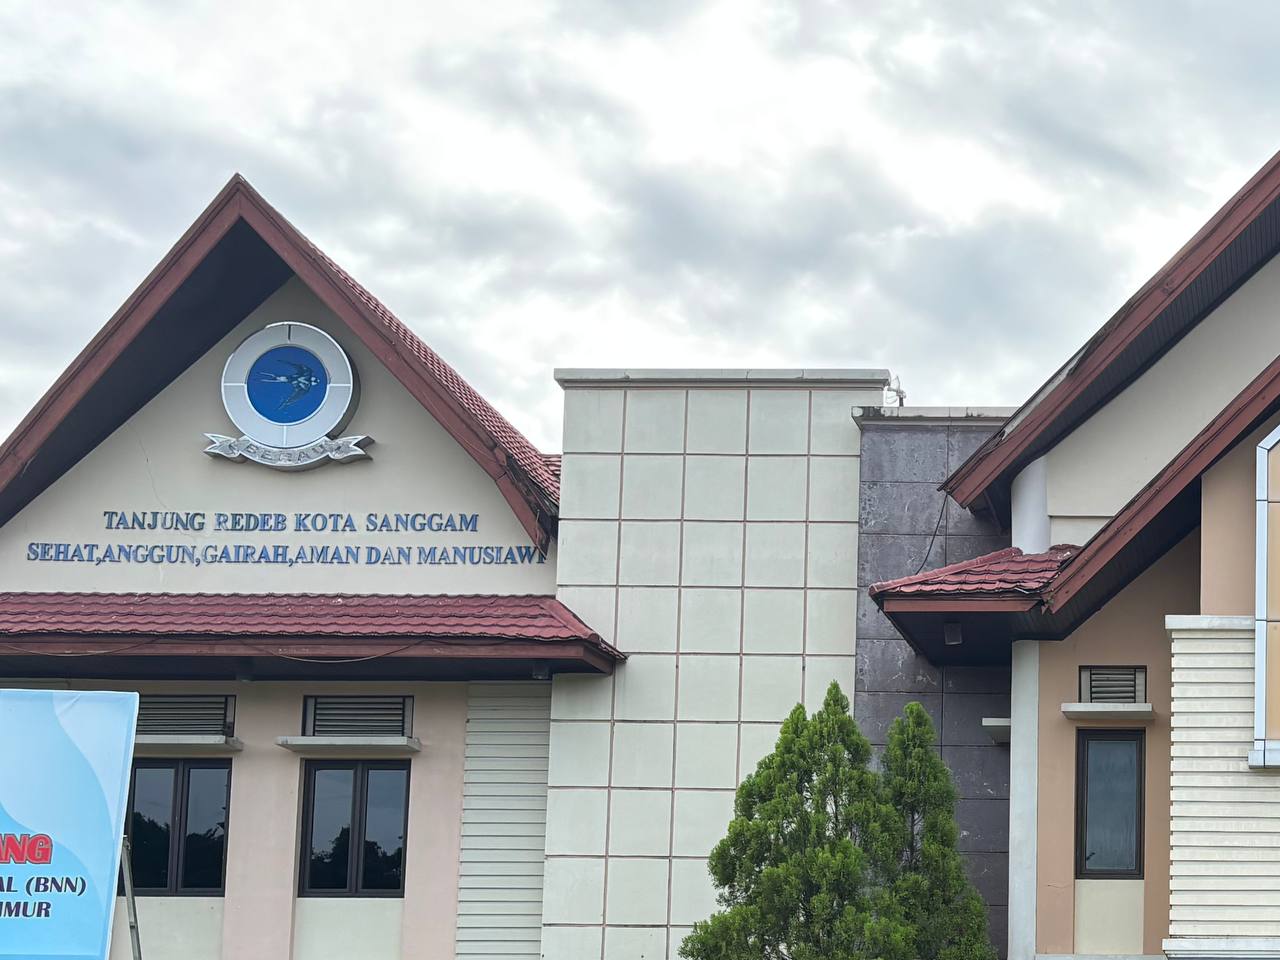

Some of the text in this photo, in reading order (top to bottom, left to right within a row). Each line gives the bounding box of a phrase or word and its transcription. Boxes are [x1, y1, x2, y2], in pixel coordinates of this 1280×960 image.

[104, 511, 479, 533] TANJUNG REDEB KOTA SANGGAM
[365, 546, 413, 565] DAN
[25, 877, 87, 896] (BNN)
